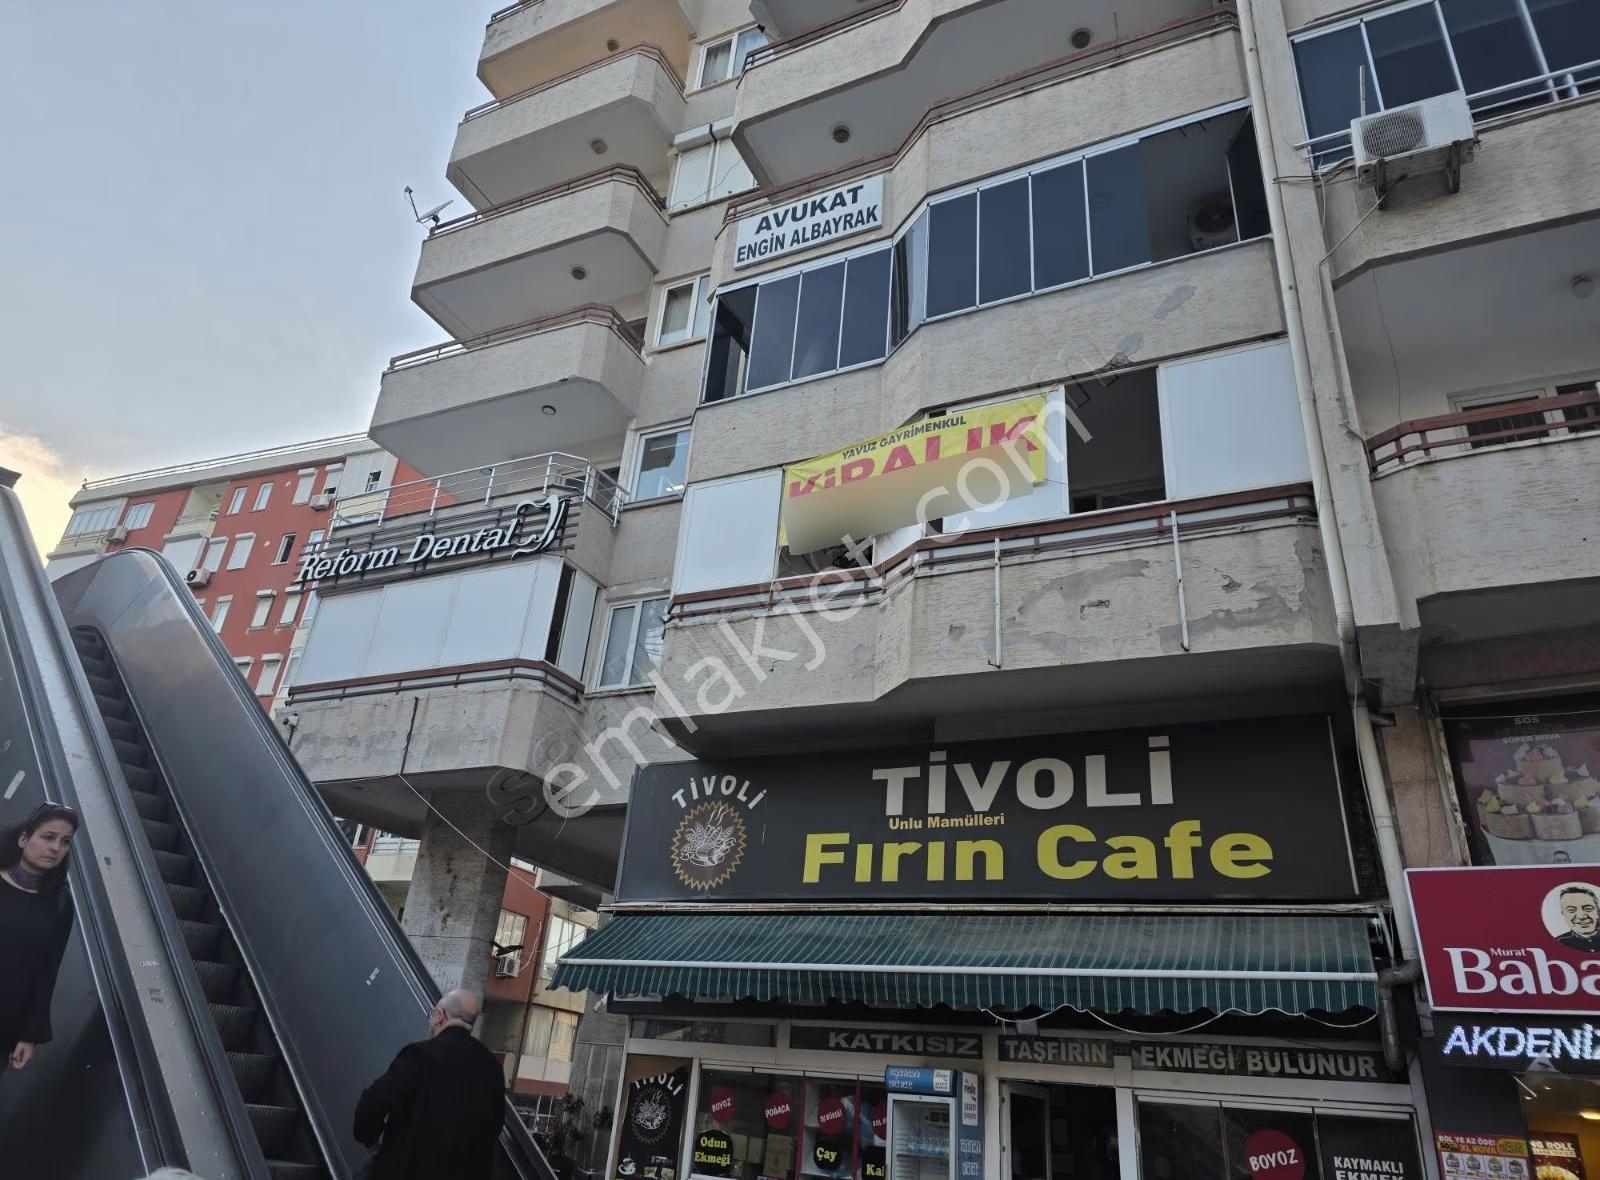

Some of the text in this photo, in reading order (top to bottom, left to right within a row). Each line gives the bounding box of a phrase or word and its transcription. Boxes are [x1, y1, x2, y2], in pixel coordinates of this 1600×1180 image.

[755, 184, 864, 234] AVUKAT
[736, 204, 878, 263] ENGİN ALBAYRAK
[842, 416, 967, 459] YAVUZ GAYRİMENKUL
[295, 518, 519, 583] Reform Dental
[872, 736, 1174, 816] TİVOLİ
[672, 775, 767, 809] TİVOLİ
[889, 812, 1005, 830] Unlu Mamülleri
[803, 820, 1274, 884] Fırın Cafe
[1490, 947, 1527, 957] Murat
[1443, 947, 1600, 996] Baba
[828, 1031, 978, 1055] KATKISIZ
[1005, 1040, 1107, 1064] TAŞFIRIN
[1246, 1050, 1377, 1078] BULUNUR
[711, 1098, 732, 1112] BOYOZ
[700, 1136, 728, 1149] Odun
[816, 1147, 838, 1161] Çay
[694, 1151, 731, 1167] Ekmeği
[1249, 1148, 1299, 1171] BOYOZ
[1333, 1156, 1404, 1174] KAYMAKLI
